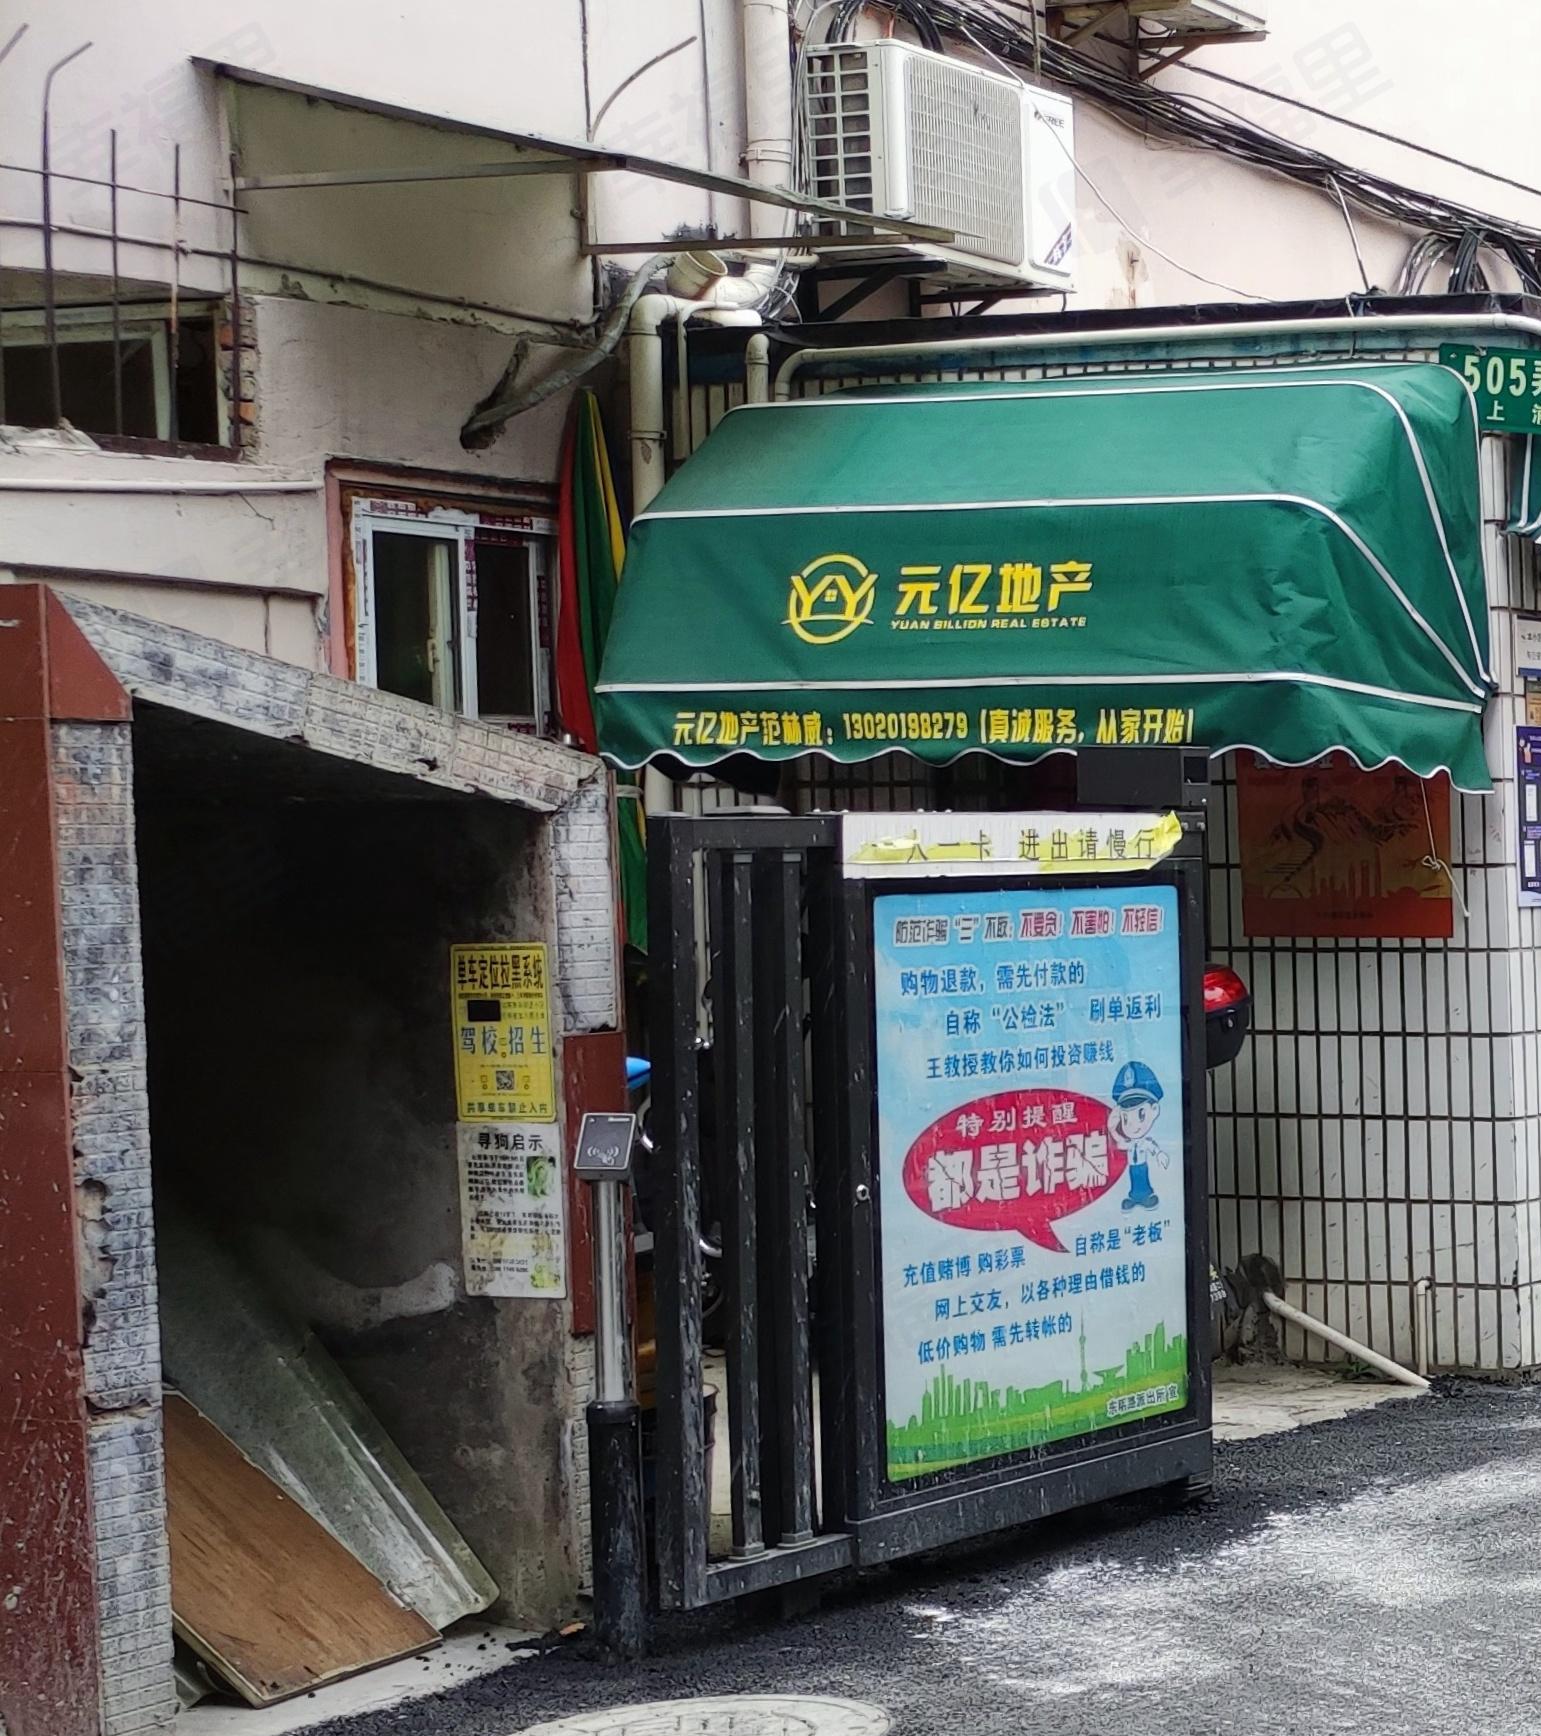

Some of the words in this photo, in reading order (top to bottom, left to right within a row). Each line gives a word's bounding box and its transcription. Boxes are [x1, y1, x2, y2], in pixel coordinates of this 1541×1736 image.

[895, 560, 1094, 615] 元亿地产
[890, 619, 930, 631] YUAN
[990, 617, 1028, 630] REAL
[1018, 827, 1156, 862] 进出请慢行
[457, 953, 544, 991] 单车定位拉黑系统
[1089, 993, 1163, 1024] 刷单返利
[461, 1025, 547, 1056] 驾校招生
[926, 1040, 1116, 1080] 王教授教你如何投资赚钱
[955, 1101, 1079, 1138] 特别提醒
[477, 1132, 544, 1151] 寻狗启示
[926, 1130, 1110, 1213] 都是诈骗
